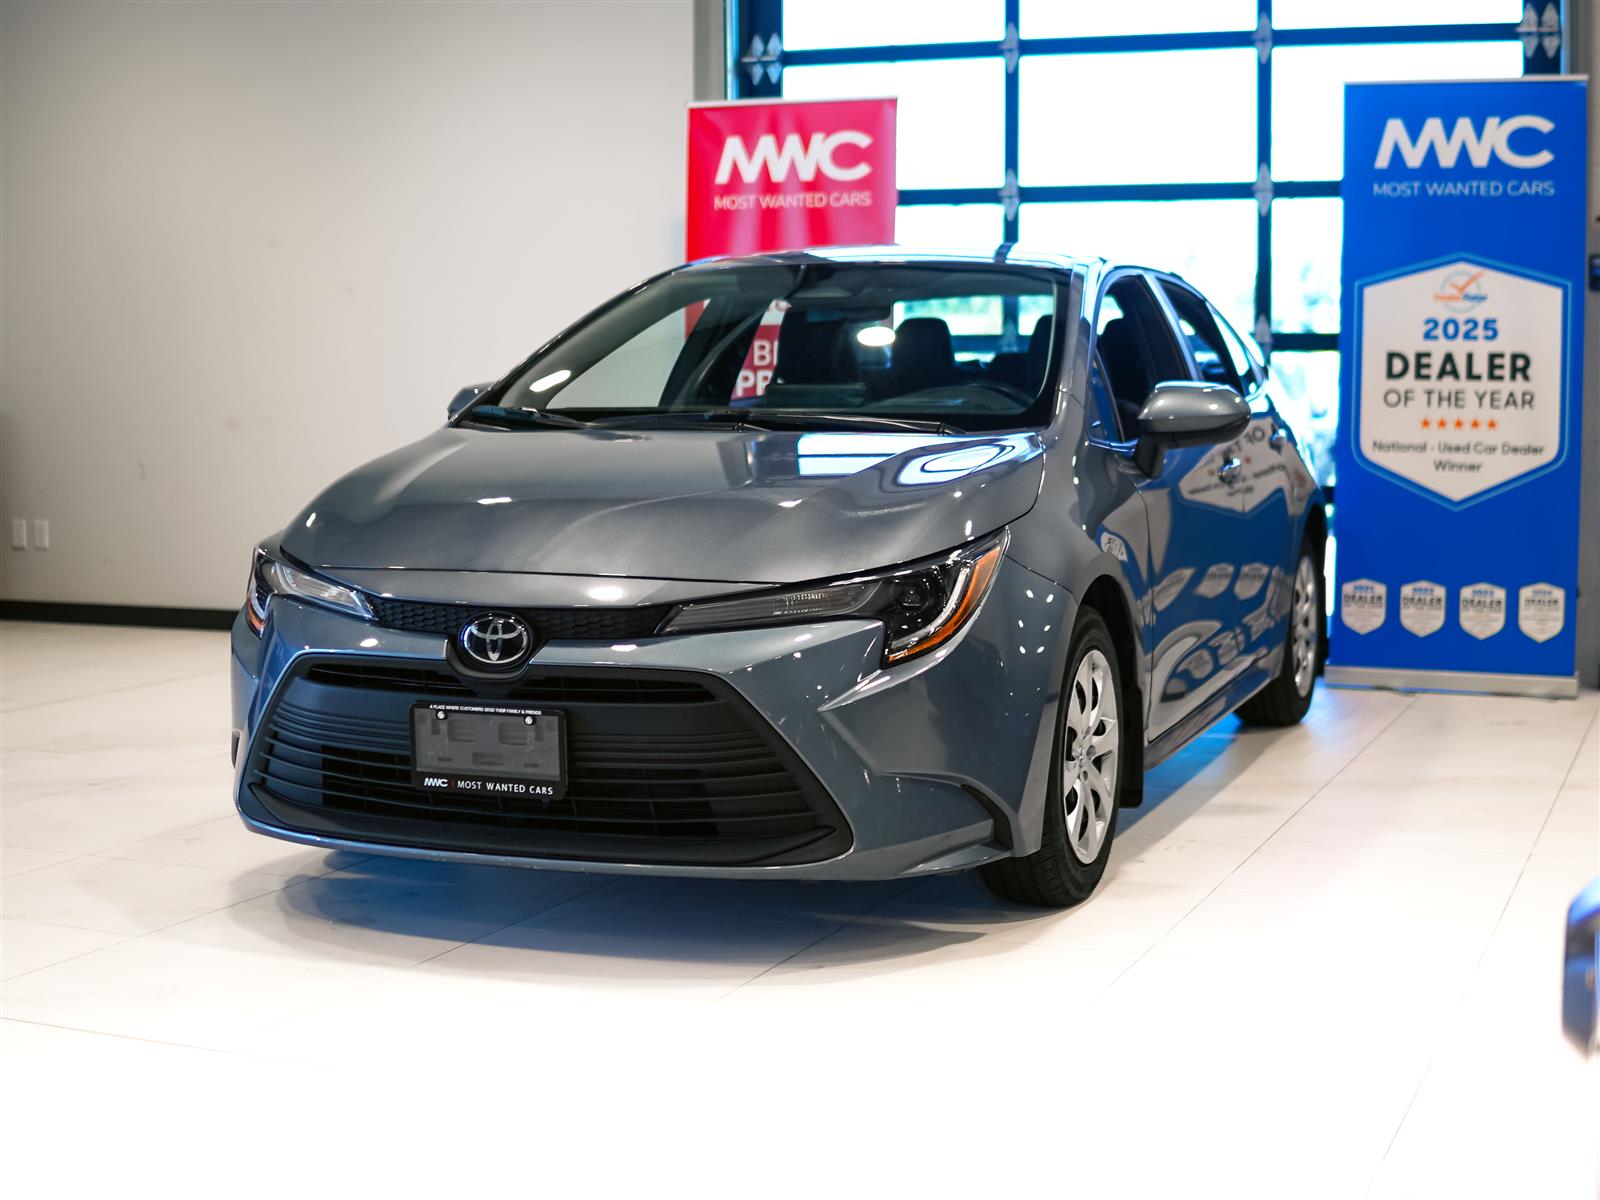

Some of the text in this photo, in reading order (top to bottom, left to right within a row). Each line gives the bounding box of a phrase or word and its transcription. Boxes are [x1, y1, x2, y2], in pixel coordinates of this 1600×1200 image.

[1374, 114, 1556, 170] MWC
[714, 130, 873, 185] MWC
[1373, 179, 1555, 198] MOST WANTED CARS
[714, 191, 872, 211] MOST WANTED CARS
[1423, 318, 1499, 341] 2025
[1385, 352, 1531, 382] DEALER
[1383, 389, 1536, 410] OF THE YEAR
[1372, 440, 1427, 454] National
[1438, 441, 1470, 455] Used
[1474, 441, 1498, 455] Car
[1501, 442, 1544, 456] Dealer
[1433, 460, 1482, 473] Winner
[424, 777, 553, 795] MWC MOST WANTED CARS
